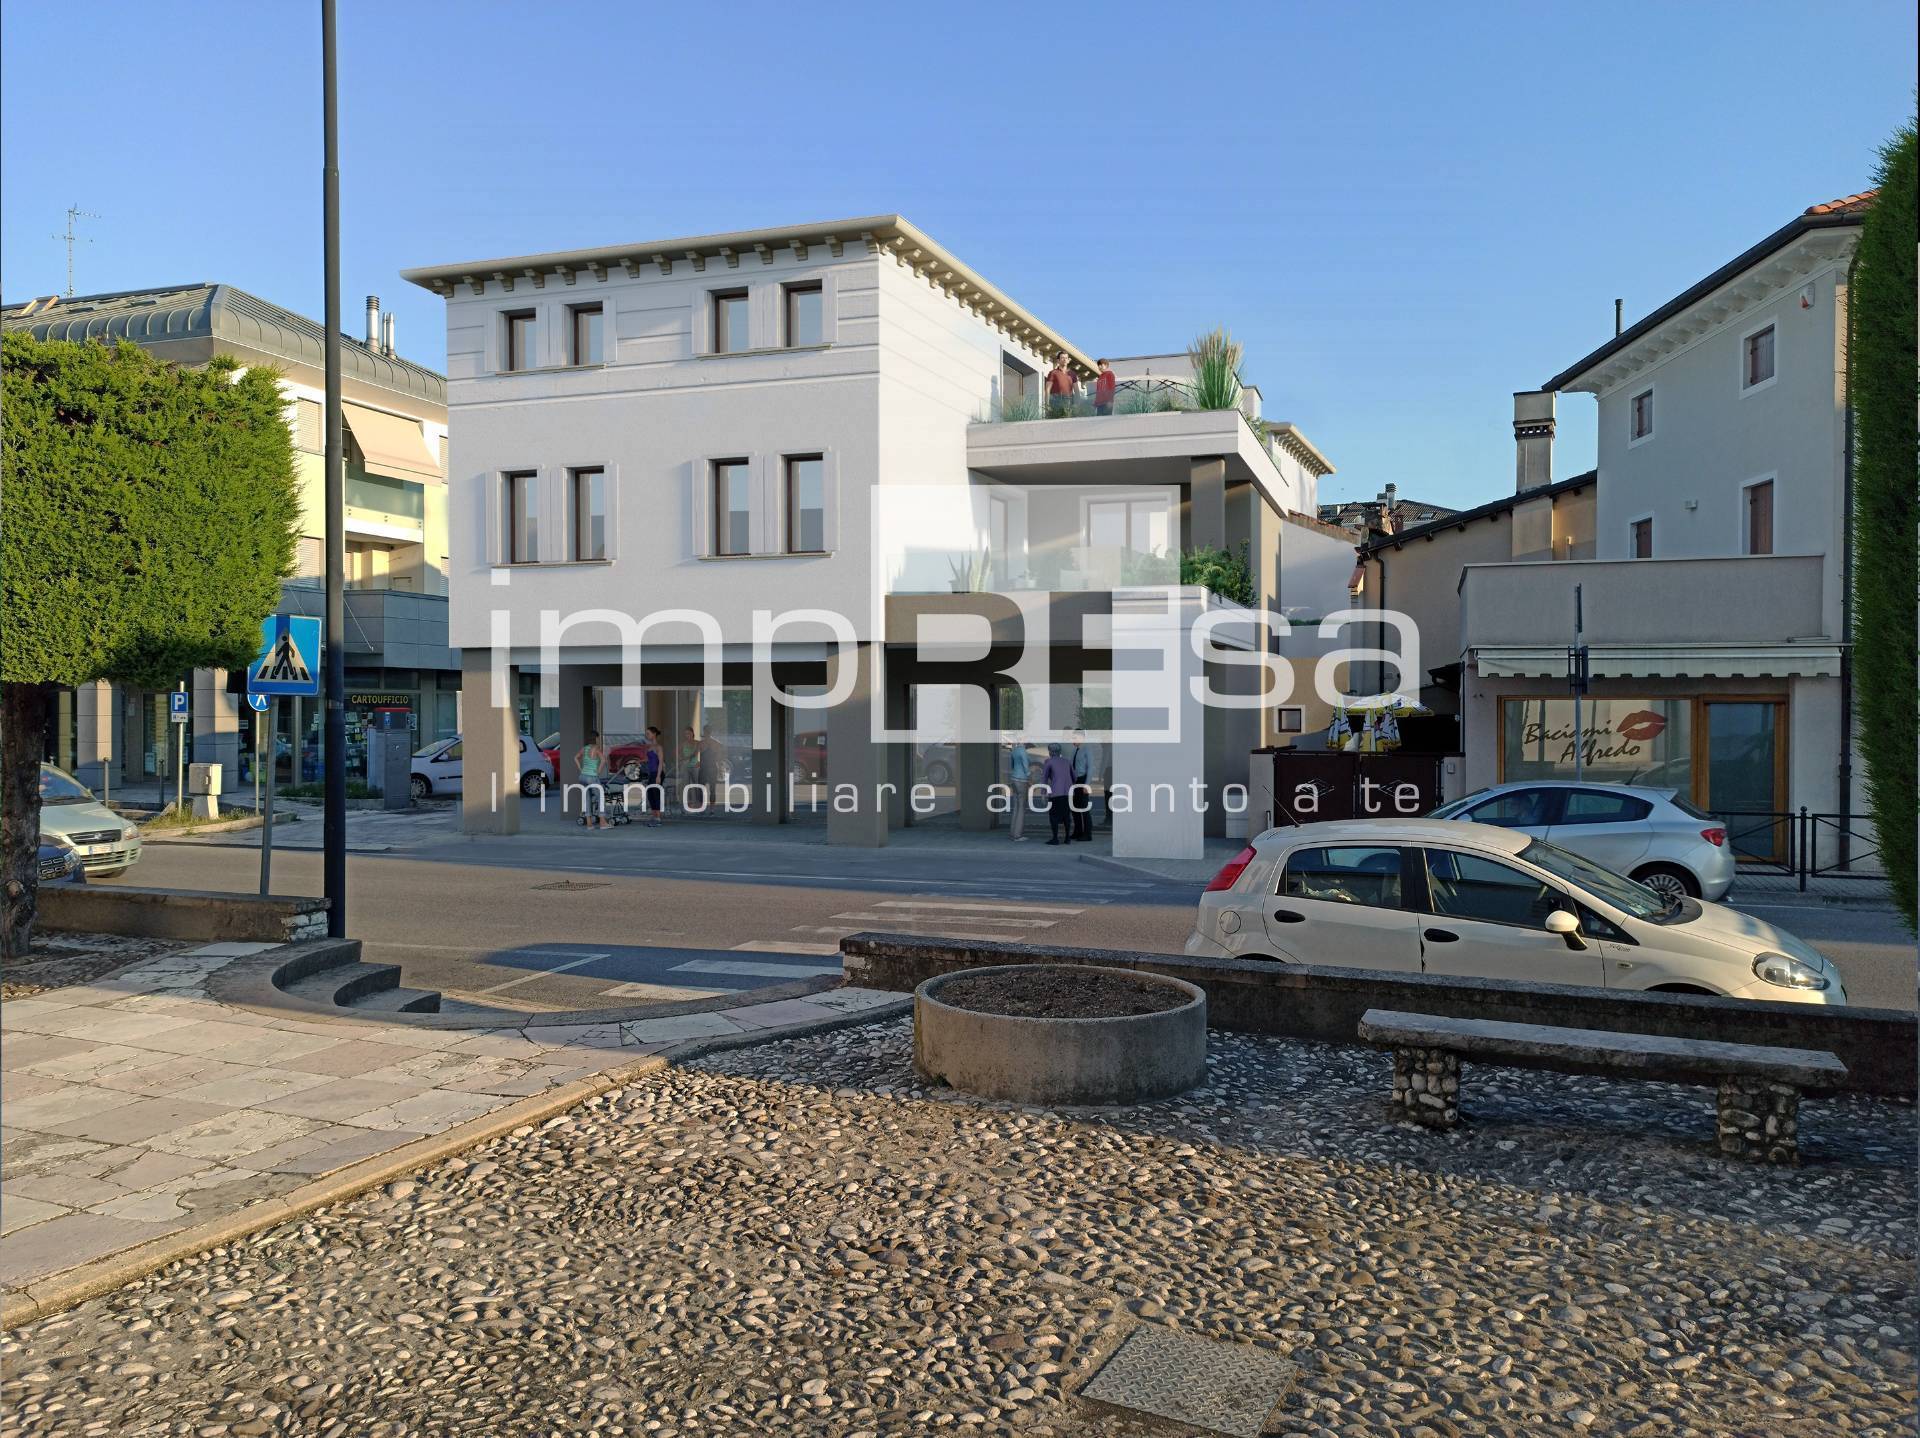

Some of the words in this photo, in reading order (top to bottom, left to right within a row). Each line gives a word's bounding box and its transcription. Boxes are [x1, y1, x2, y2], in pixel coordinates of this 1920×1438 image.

[174, 694, 185, 710] P
[351, 695, 409, 704] CARTOUFFICIO
[1560, 739, 1641, 766] Alfredo
